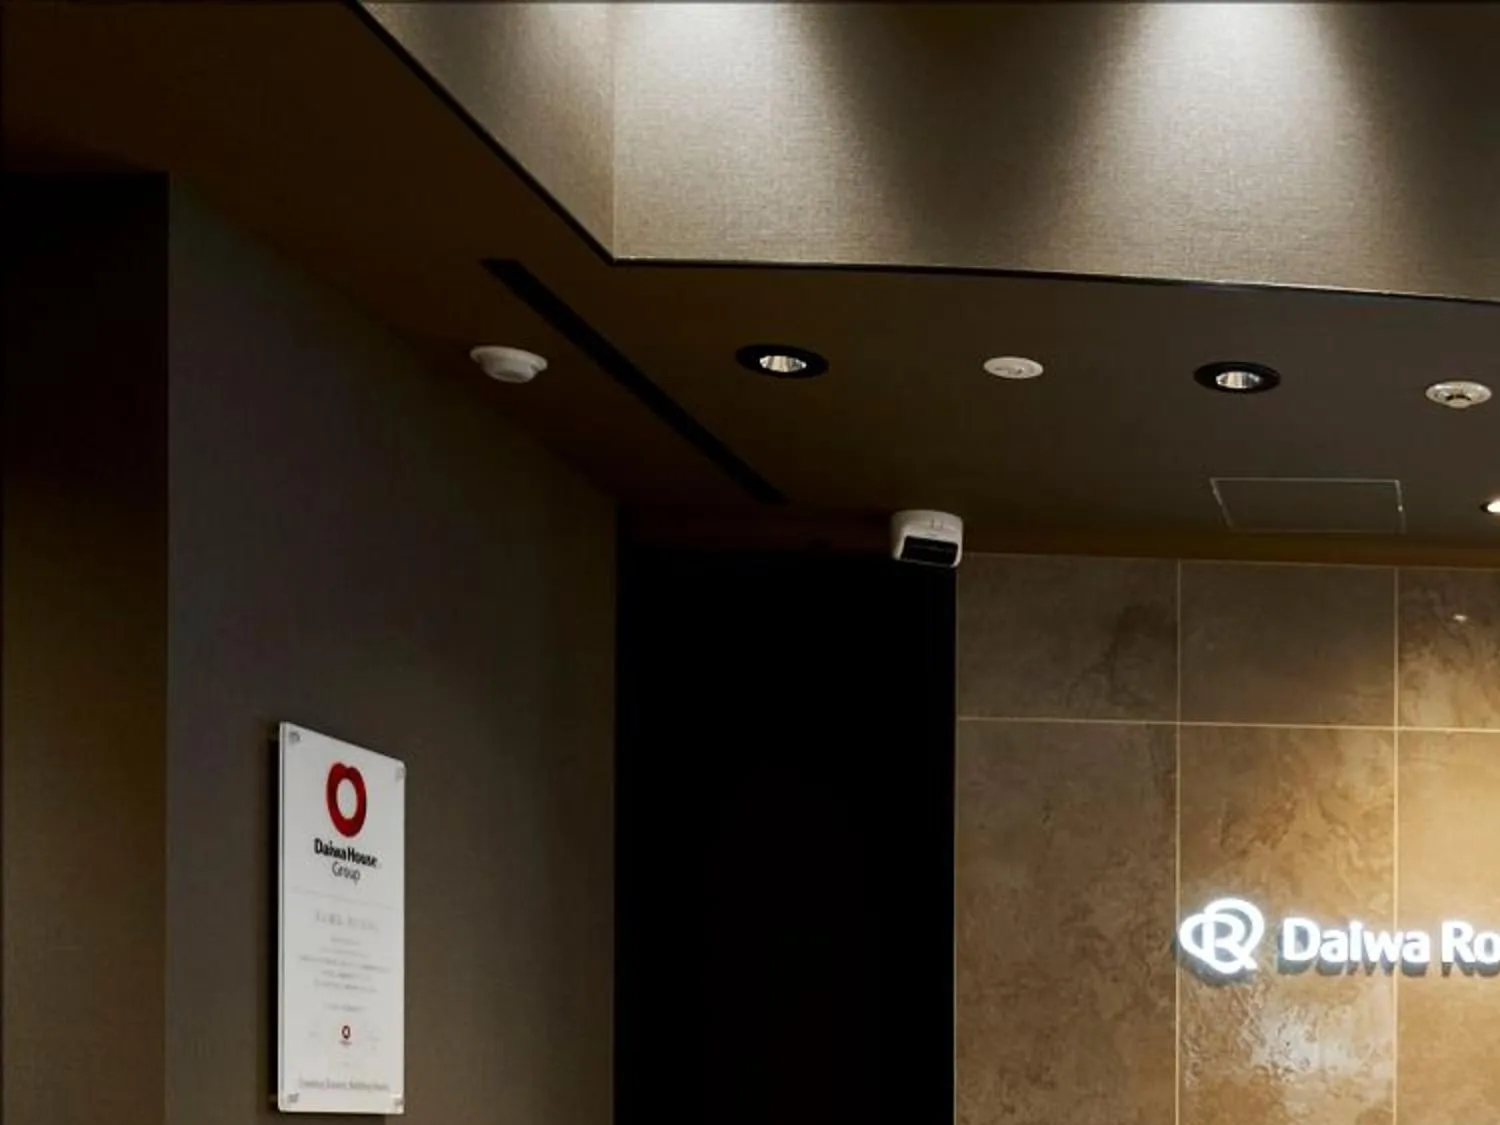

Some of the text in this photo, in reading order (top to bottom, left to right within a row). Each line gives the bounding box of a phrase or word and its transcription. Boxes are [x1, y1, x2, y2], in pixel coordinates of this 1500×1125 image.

[314, 837, 378, 867] Daiwa House
[332, 861, 361, 885] Group
[1282, 916, 1431, 964] Daiwa
